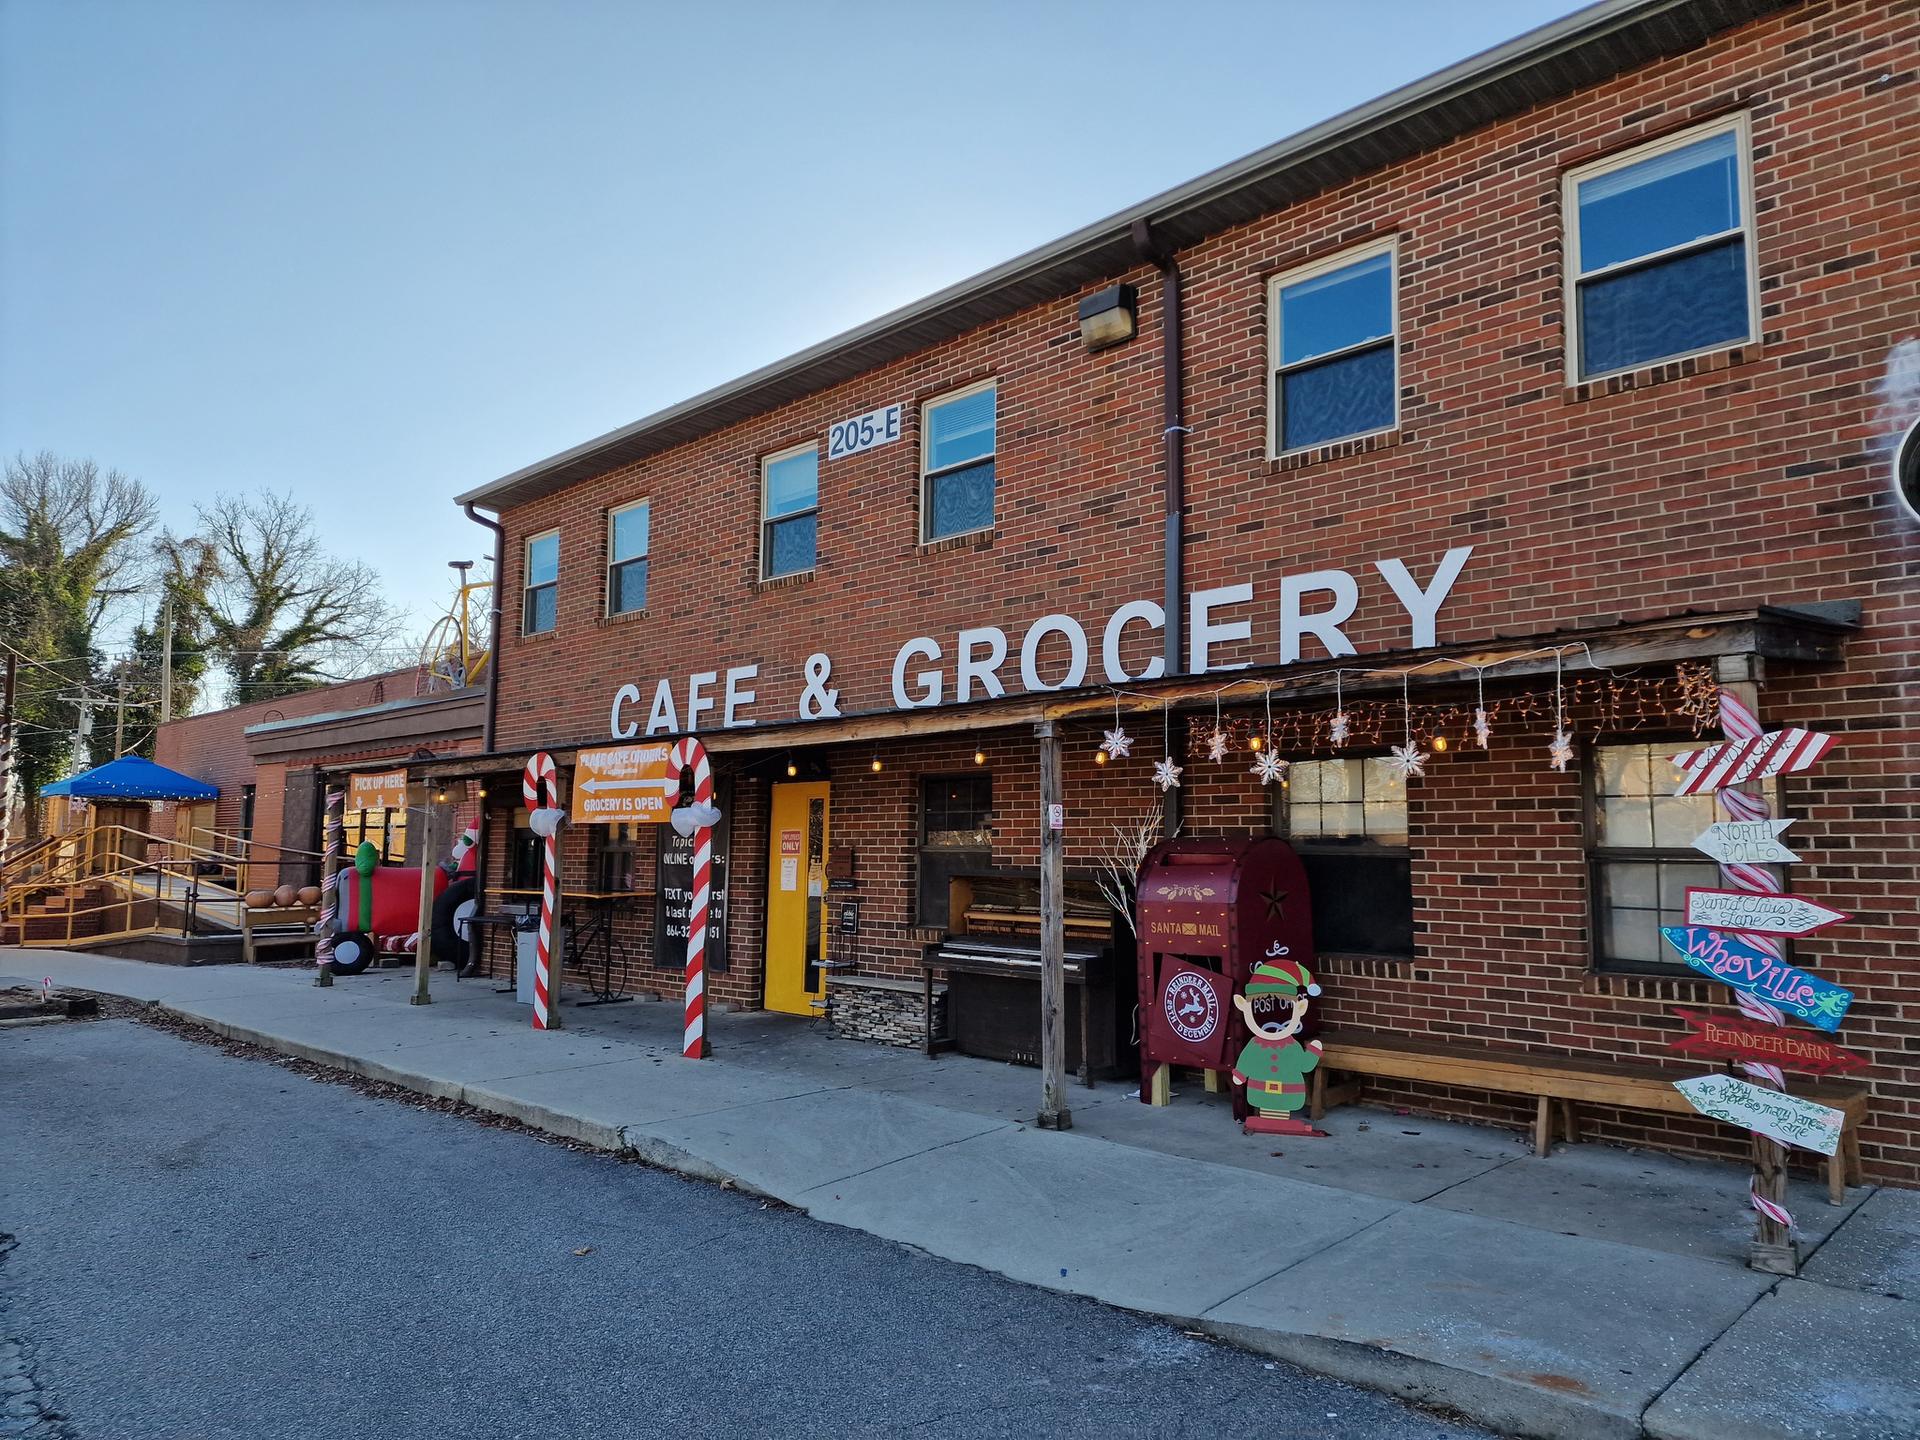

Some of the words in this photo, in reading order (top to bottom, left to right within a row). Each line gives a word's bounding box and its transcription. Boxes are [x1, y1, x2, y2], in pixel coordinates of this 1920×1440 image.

[831, 406, 898, 456] 205-E
[611, 664, 758, 738] CAFE
[799, 653, 842, 719] &
[892, 546, 1474, 709] GROCERY
[1694, 741, 1747, 770] CANDY
[1752, 733, 1796, 757] CANE
[1736, 755, 1778, 781] LANE
[355, 777, 372, 791] PICK
[373, 776, 384, 789] UP
[384, 773, 405, 789] HERE
[583, 798, 622, 812] GROCERY
[623, 797, 633, 811] IS
[635, 796, 664, 810] OPEN
[1711, 819, 1774, 842] NORTH
[782, 841, 799, 851] ONLY
[1721, 842, 1779, 862] POLE
[664, 888, 682, 900] TEXT
[1691, 893, 1742, 911] Santa
[1742, 895, 1793, 915] Claus
[1151, 921, 1182, 935] SANTA
[1199, 923, 1221, 937] MAIL
[1720, 911, 1783, 928] Lane
[1168, 975, 1203, 995] REINDEER
[1201, 981, 1216, 1008] MAIL
[1254, 997, 1275, 1014] POST
[1177, 1015, 1215, 1039] DECEMBER
[1705, 1023, 1783, 1054] REINDEER
[1785, 1038, 1830, 1060] BARN
[1697, 1082, 1715, 1096] are
[1725, 1078, 1752, 1099] Why
